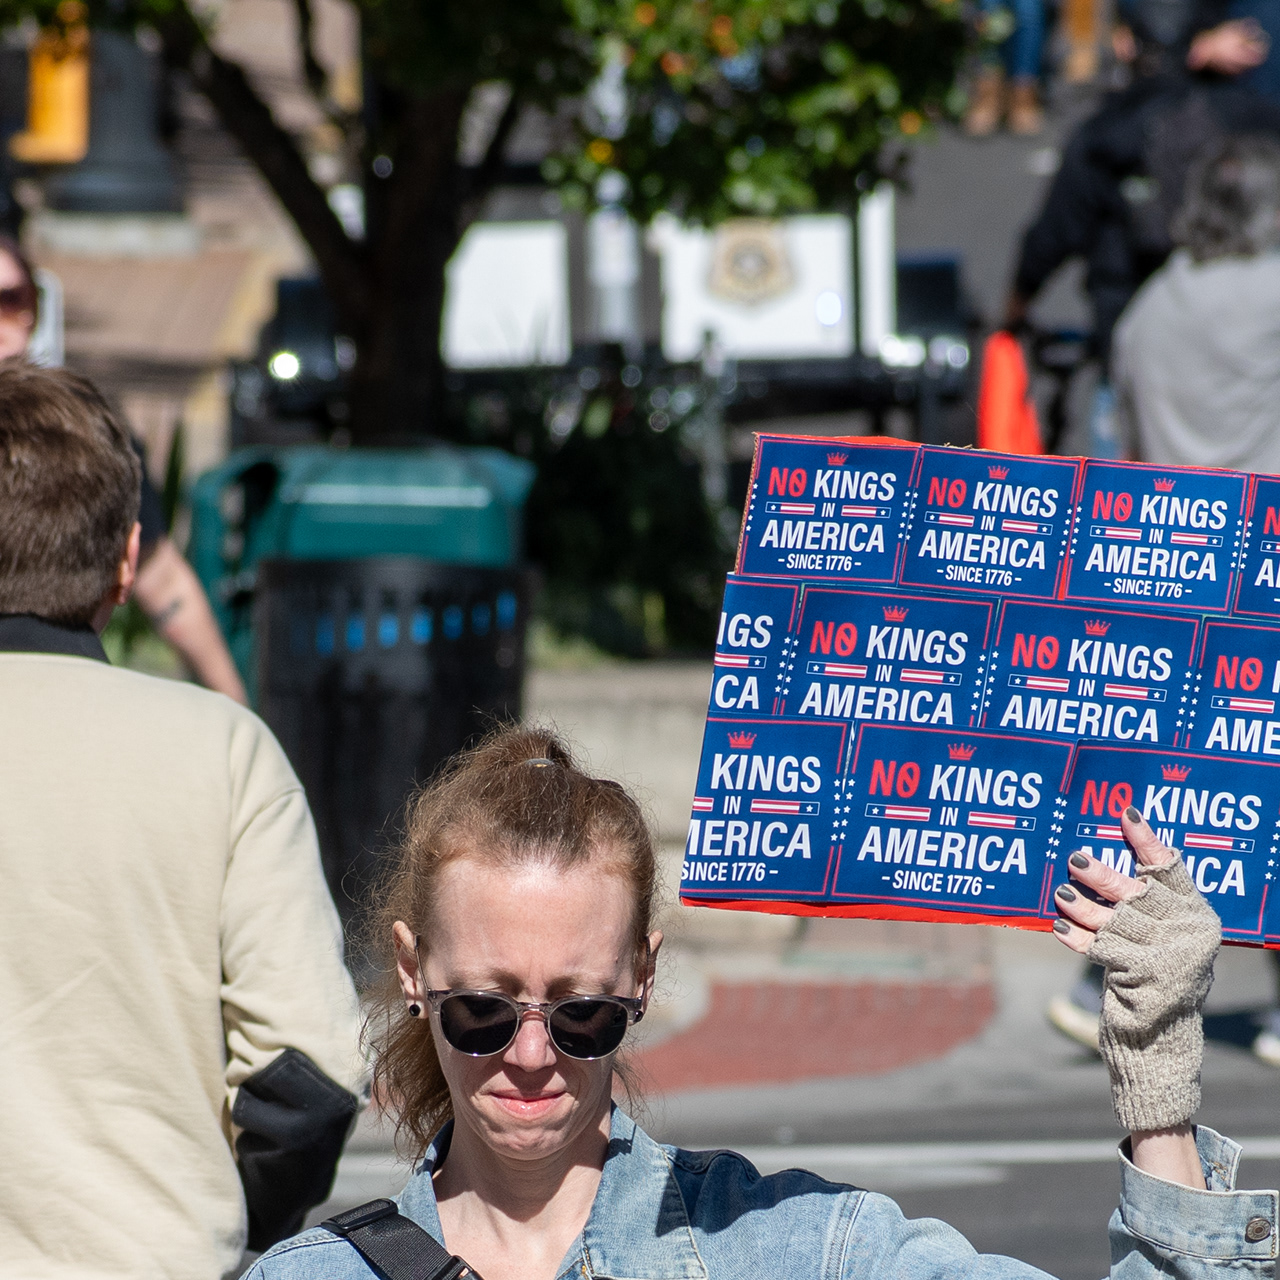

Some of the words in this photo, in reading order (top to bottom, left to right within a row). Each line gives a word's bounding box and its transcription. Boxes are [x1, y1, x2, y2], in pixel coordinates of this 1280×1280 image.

[814, 470, 896, 501] KINGS
[973, 482, 1058, 519] KINGS
[822, 503, 835, 517] IN
[981, 516, 995, 531] IN
[1140, 495, 1227, 531] KINGS
[760, 521, 884, 552] AMERICA
[919, 529, 1046, 570] AMERICA
[1149, 529, 1163, 544] IN
[1085, 544, 1216, 582] AMERICA
[717, 612, 773, 648] GS
[866, 626, 968, 665] KINGS
[875, 665, 892, 682] IN
[1066, 639, 1172, 682] KINGS
[799, 682, 953, 725] AMERICA
[1078, 679, 1095, 696] IN
[1000, 692, 1161, 742] AMERICA
[711, 754, 820, 793] KINGS
[929, 765, 1042, 809] KINGS
[723, 796, 741, 814] IN
[940, 807, 958, 826] IN
[1142, 785, 1261, 831] KINGS
[857, 826, 1026, 876] AMERICA
